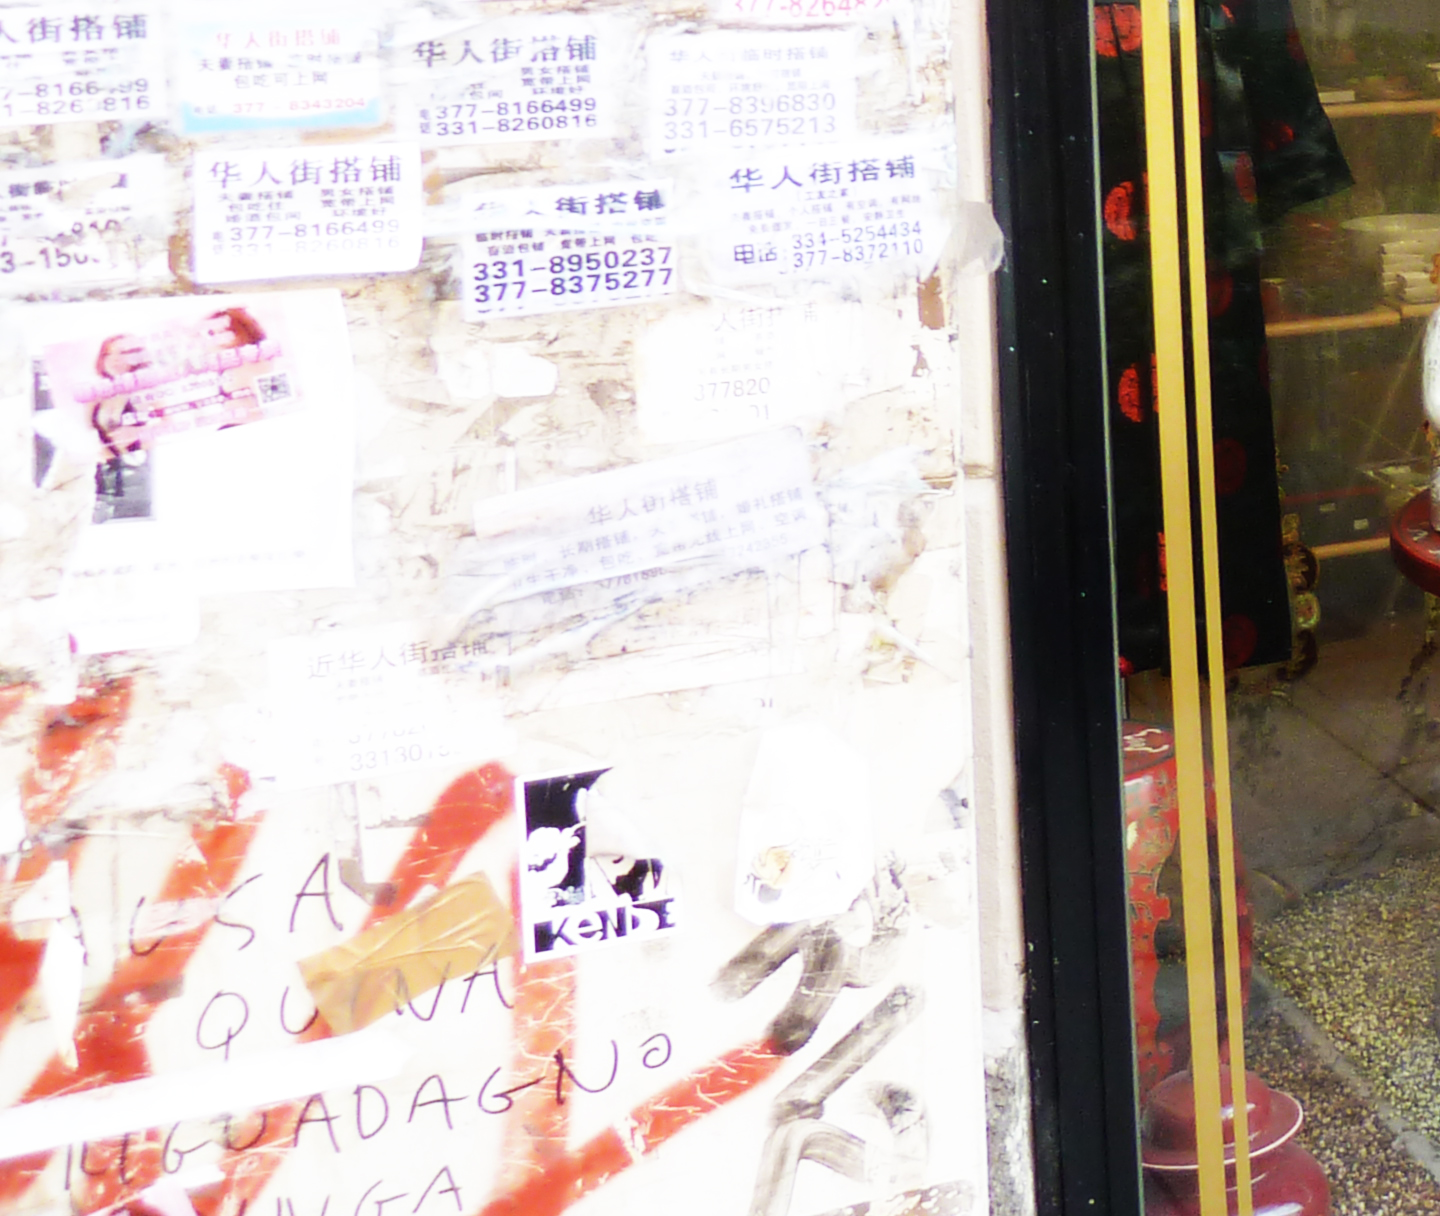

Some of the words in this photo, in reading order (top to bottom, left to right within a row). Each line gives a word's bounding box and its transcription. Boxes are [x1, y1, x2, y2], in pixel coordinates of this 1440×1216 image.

[436, 98, 597, 120] 377-8166499
[437, 114, 597, 136] 331-8260816
[207, 155, 402, 189] 华人街搭铺
[730, 155, 914, 193] 华人街搭铺
[229, 219, 400, 242] 377-8166499
[473, 246, 672, 281] 331-8950237
[475, 267, 673, 303] 377-8375277
